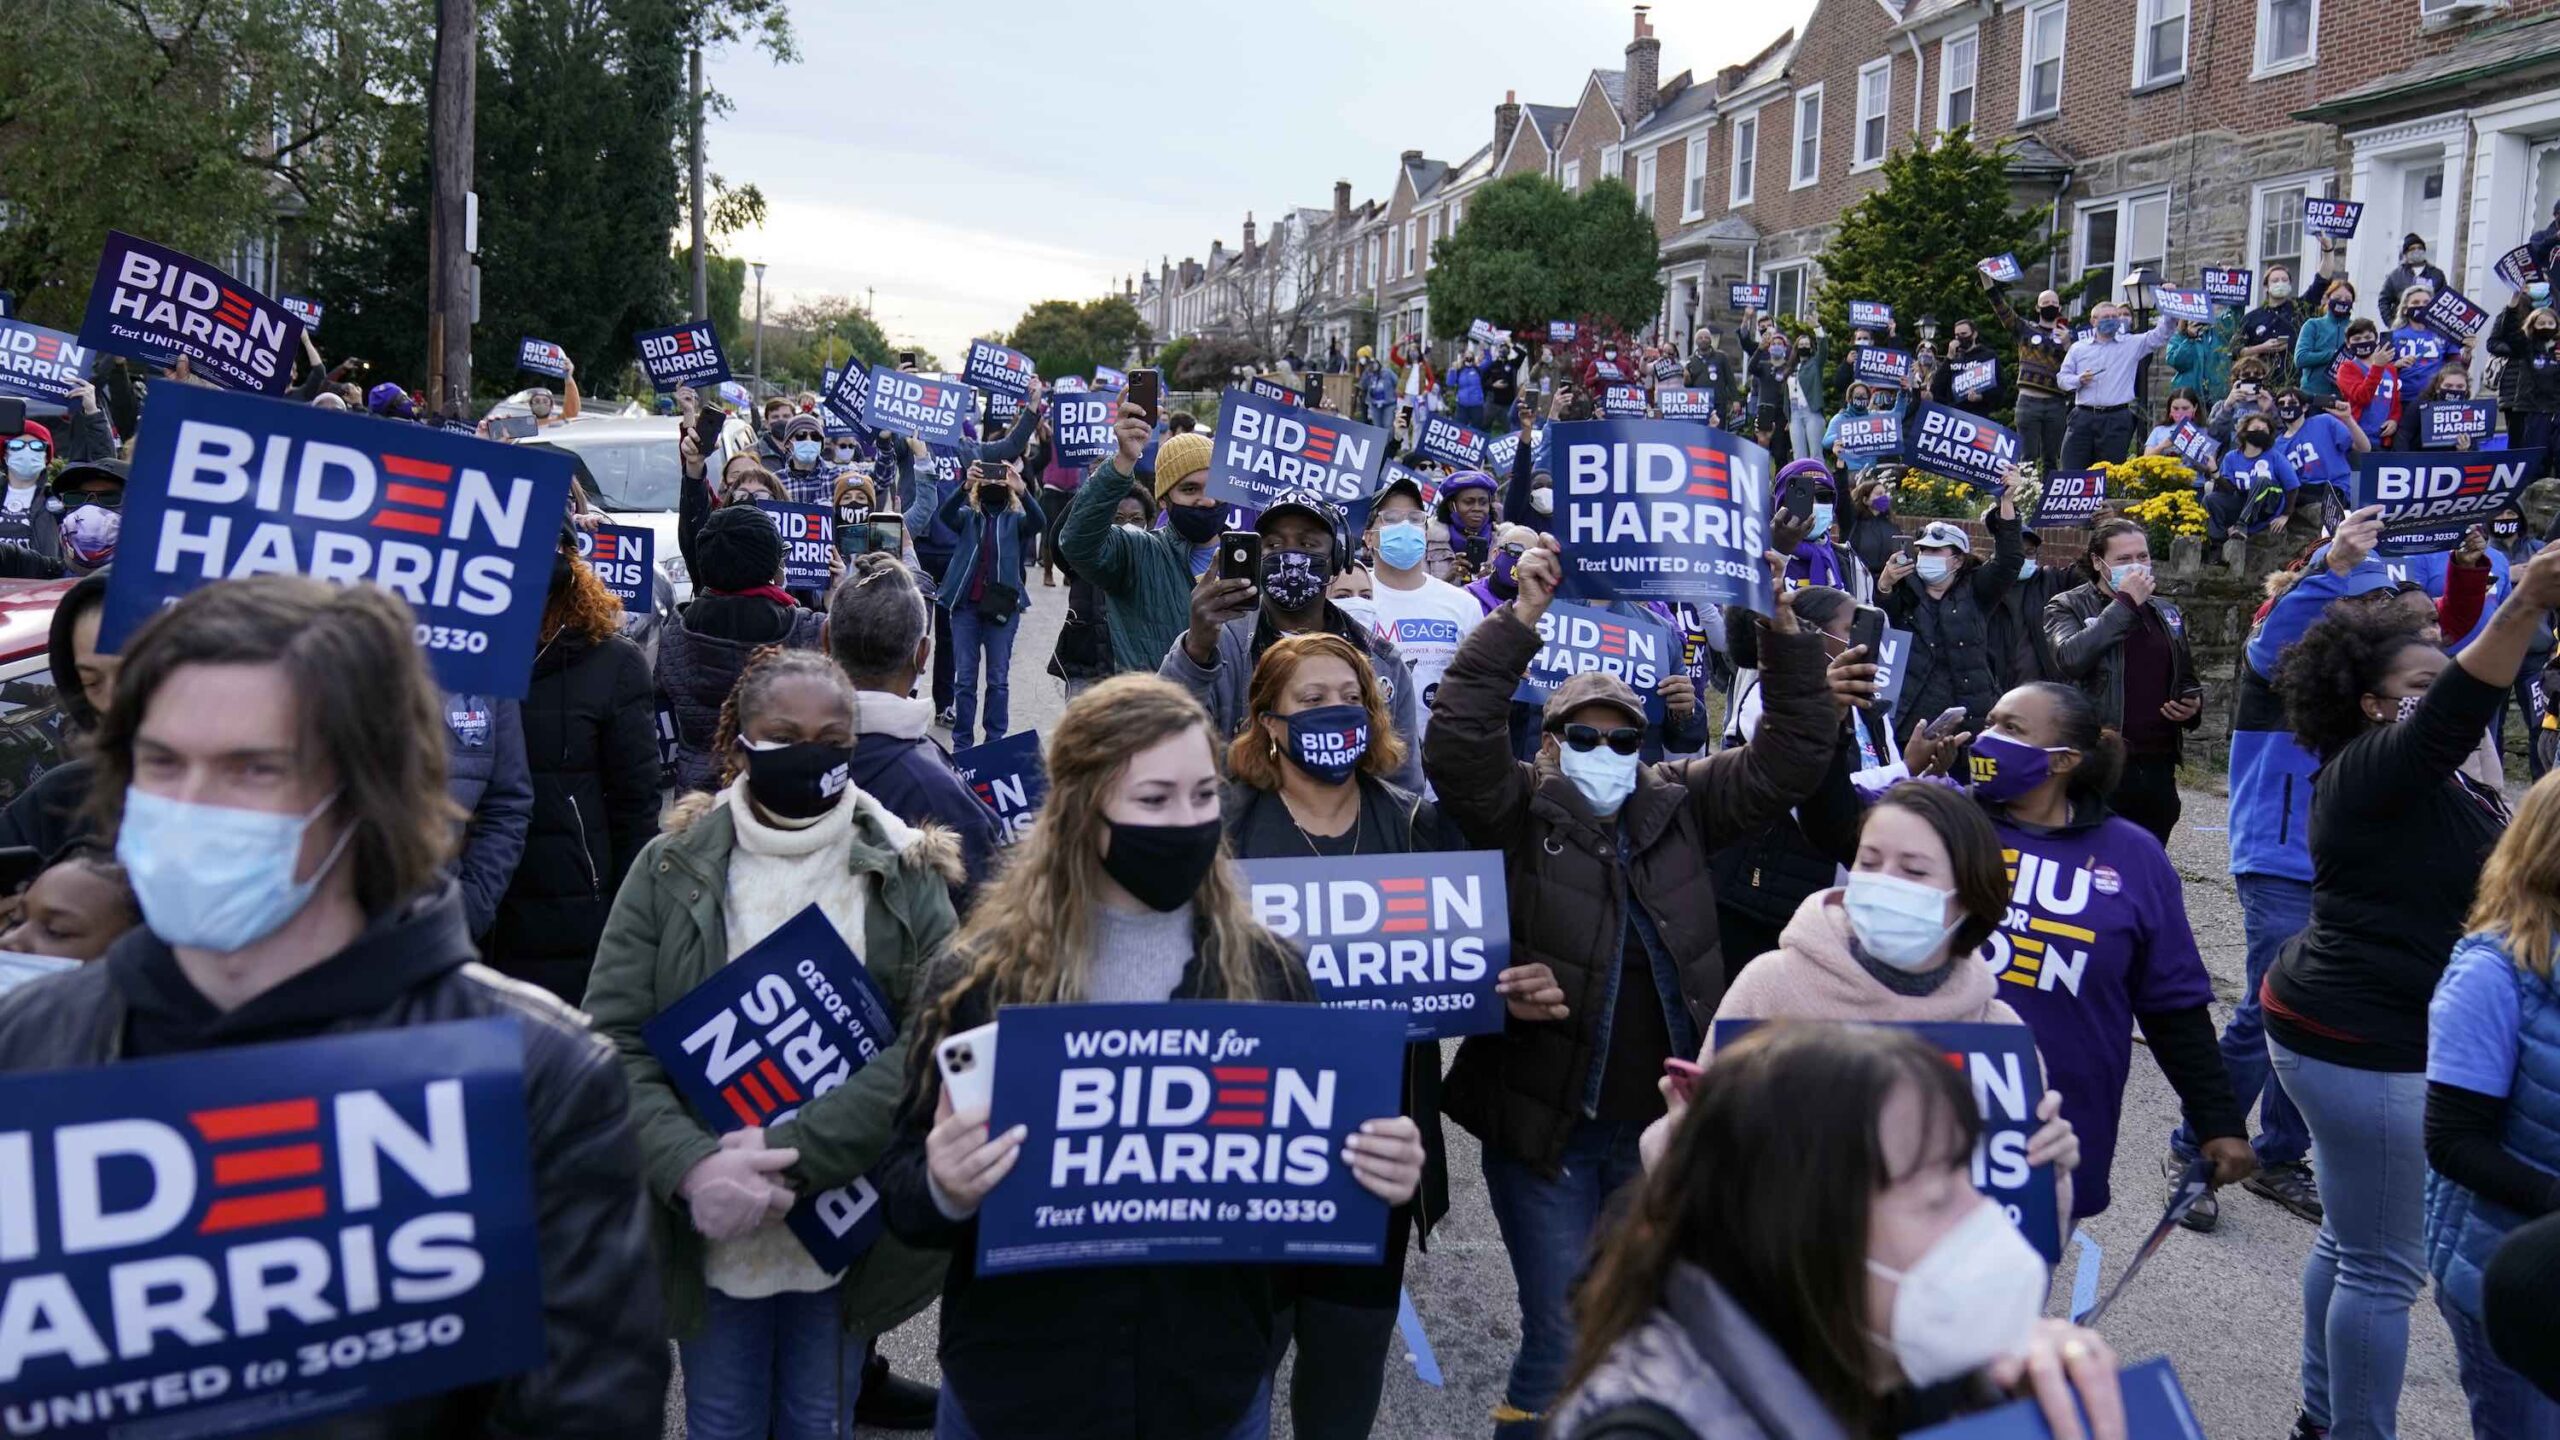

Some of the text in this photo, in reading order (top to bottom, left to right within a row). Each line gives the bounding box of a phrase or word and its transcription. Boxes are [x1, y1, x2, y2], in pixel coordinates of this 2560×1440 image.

[2306, 214, 2354, 228] HARRIS
[2307, 201, 2358, 218] BIDEN
[2513, 246, 2539, 282] BIDEN
[1732, 285, 1767, 297] BIDEN
[2205, 271, 2248, 285] BIDEN
[2205, 283, 2247, 296] HARRIS
[118, 249, 287, 353] BIDEN
[283, 297, 322, 317] BIDEN
[1732, 294, 1766, 303] HARRIS
[1852, 303, 1889, 316] BIDEN
[2155, 288, 2206, 305] BIDEN
[2158, 299, 2209, 314] HARRIS
[2437, 291, 2485, 328] BIDEN
[1852, 311, 1890, 323] HARRIS
[2428, 303, 2476, 336] HARRIS
[109, 286, 278, 378] HARRIS
[641, 328, 712, 359] BIDEN
[0, 327, 85, 367] IDEN
[110, 323, 264, 391] Text UNITED to 30330
[523, 352, 567, 369] HARRIS
[974, 344, 1032, 374] BIDEN
[1862, 349, 1907, 366] BIDEN
[0, 350, 79, 385] ARRIS
[648, 349, 718, 376] HARRIS
[971, 359, 1032, 388] HARRIS
[1860, 359, 1905, 376] HARRIS
[1954, 363, 1991, 382] BIDEN
[877, 374, 960, 411] BIDEN
[1607, 387, 1646, 401] BIDEN
[1954, 374, 1993, 393] HARRIS
[873, 393, 956, 427] HARRIS
[1606, 399, 1647, 409] HARRIS
[1662, 392, 1709, 404] BIDEN
[1662, 404, 1709, 414] HARRIS
[888, 415, 917, 431] UNITED
[925, 426, 948, 436] 30330
[1060, 401, 1118, 424] BIDE
[2433, 409, 2486, 424] BIDEN
[1060, 425, 1118, 445] HARR
[1231, 404, 1370, 471] BIDEN
[1429, 418, 1487, 452] BIDEN
[1840, 417, 1896, 436] BIDEN
[1841, 430, 1897, 446] HARRIS
[1922, 410, 2016, 458] BIDEN
[2433, 421, 2486, 433] HARRIS
[1076, 447, 1104, 456] UNITED
[1423, 431, 1481, 463] HARRIS
[1917, 432, 2010, 476] HARRIS
[1226, 440, 1362, 500] HARRIS
[1228, 474, 1251, 489] Text
[1568, 442, 1762, 513] BIDEN
[1932, 458, 1965, 473] UNITED
[1974, 471, 2001, 485] 30330
[2376, 461, 2527, 500] BIDEN
[167, 419, 534, 550] BIDEN
[2049, 475, 2105, 497] BIDEN
[840, 506, 869, 524] VOTE
[2042, 497, 2104, 511] HARRIS
[2376, 491, 2510, 523] HARRIS
[1569, 501, 1764, 560] HARRIS
[2386, 534, 2425, 543] UNITED
[2433, 531, 2459, 541] 30330
[2494, 521, 2519, 533] VOTE
[154, 509, 515, 616] HARRIS
[786, 542, 834, 564] ARRIS
[1577, 556, 1761, 584] Text UNITED to 30330
[414, 623, 489, 655] 0330
[1536, 611, 1656, 661] BIDEN
[1528, 676, 1548, 688] Text
[452, 710, 485, 721] BIDEN
[453, 719, 487, 728] HARRIS
[1301, 724, 1368, 751] BIDEN
[1303, 743, 1368, 767] HARRIS
[1250, 875, 1483, 938] BIDEN
[1306, 936, 1488, 988] ARRIS
[1979, 931, 2089, 998] DEN
[796, 958, 851, 1027] 30330
[1412, 993, 1476, 1014] 30330
[1064, 1029, 1260, 1062] WOMEN for
[1055, 1065, 1337, 1132] BIDEN
[0, 1078, 472, 1264] IDEN
[1050, 1133, 1330, 1188] HARRIS
[1035, 1198, 1337, 1228] Text WOMEN to 30330
[0, 1211, 485, 1384] ARRIS
[3, 1313, 466, 1437] UNITED to 30330
